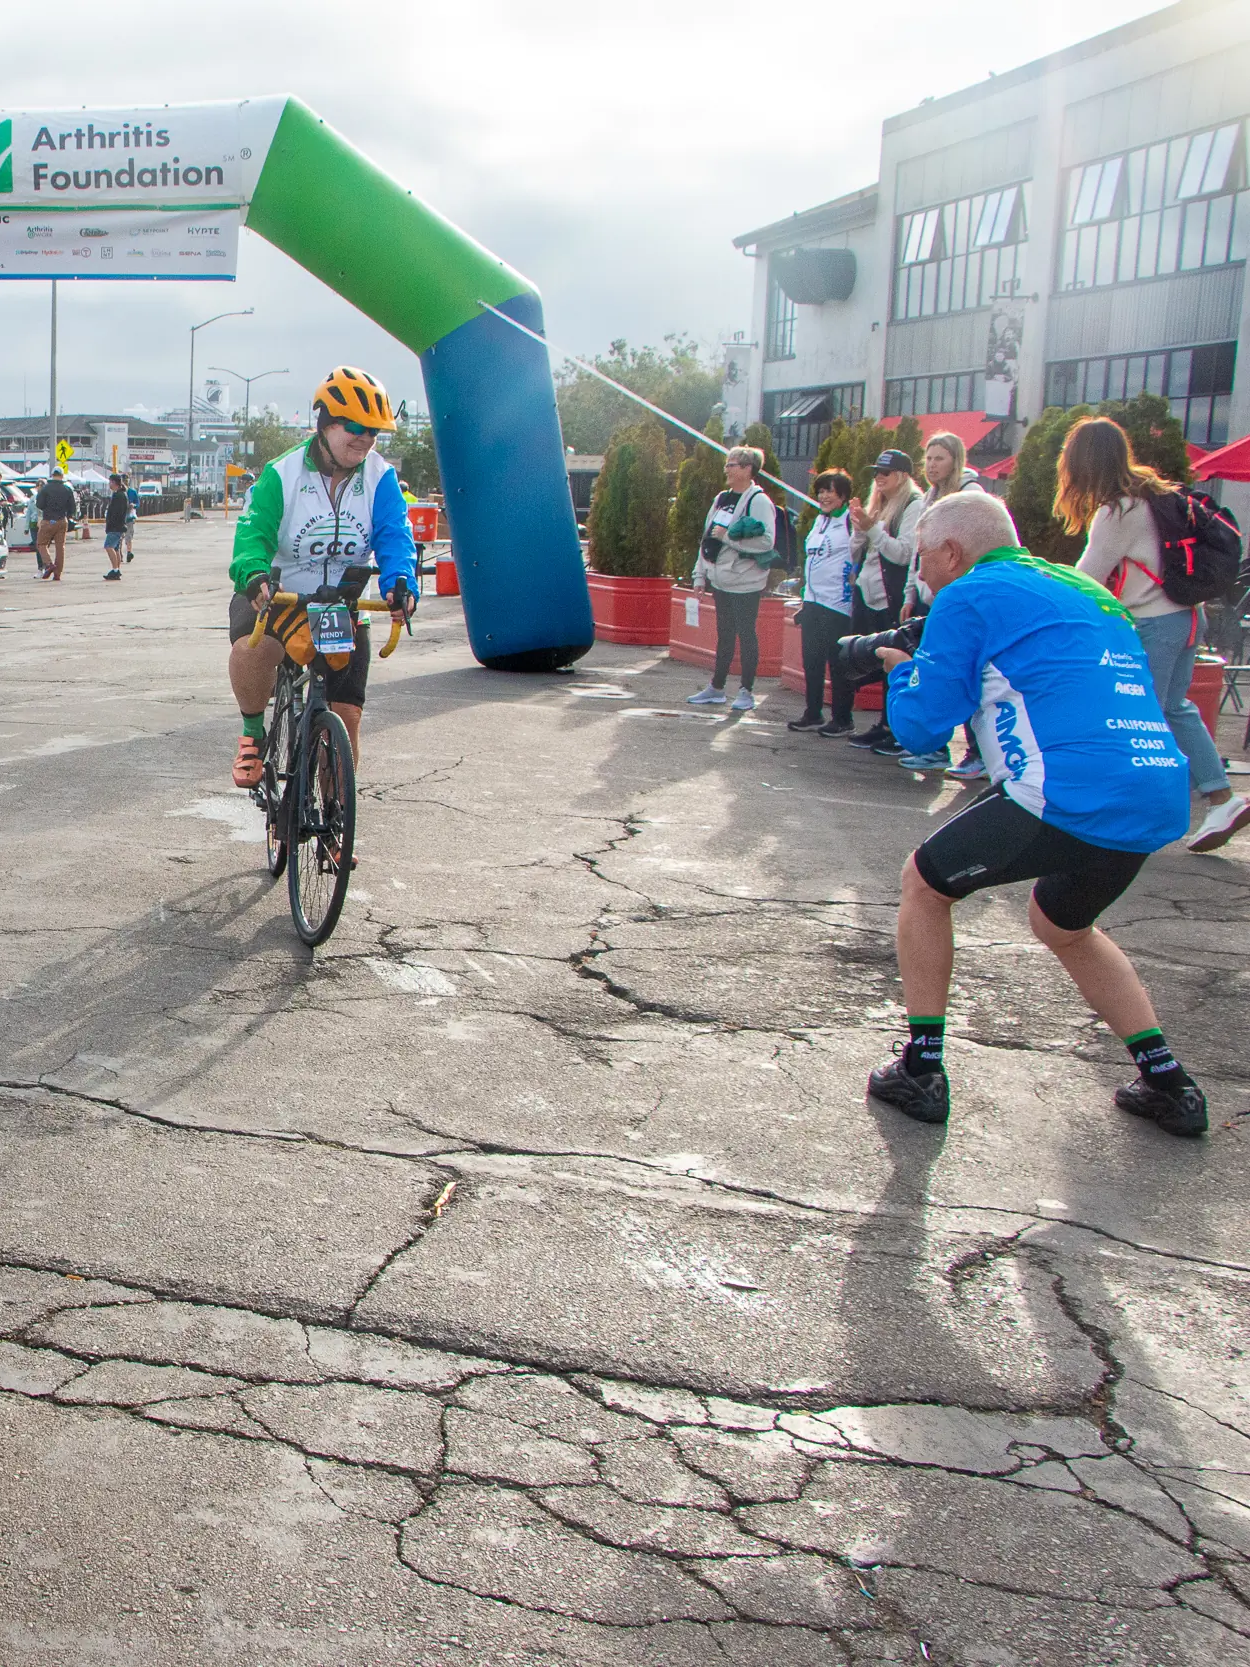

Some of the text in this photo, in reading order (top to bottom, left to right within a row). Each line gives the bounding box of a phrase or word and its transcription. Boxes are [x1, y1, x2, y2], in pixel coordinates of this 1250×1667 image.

[31, 122, 170, 151] Arthritis
[33, 157, 223, 190] Foundation
[293, 514, 324, 559] CALIFORNIA
[309, 540, 357, 556] CCC
[319, 630, 345, 639] WENDY
[1105, 718, 1172, 733] CALIFORNIA
[994, 701, 1029, 782] AMG
[1130, 737, 1166, 751] COAST
[1131, 756, 1179, 768] CLASSIC
